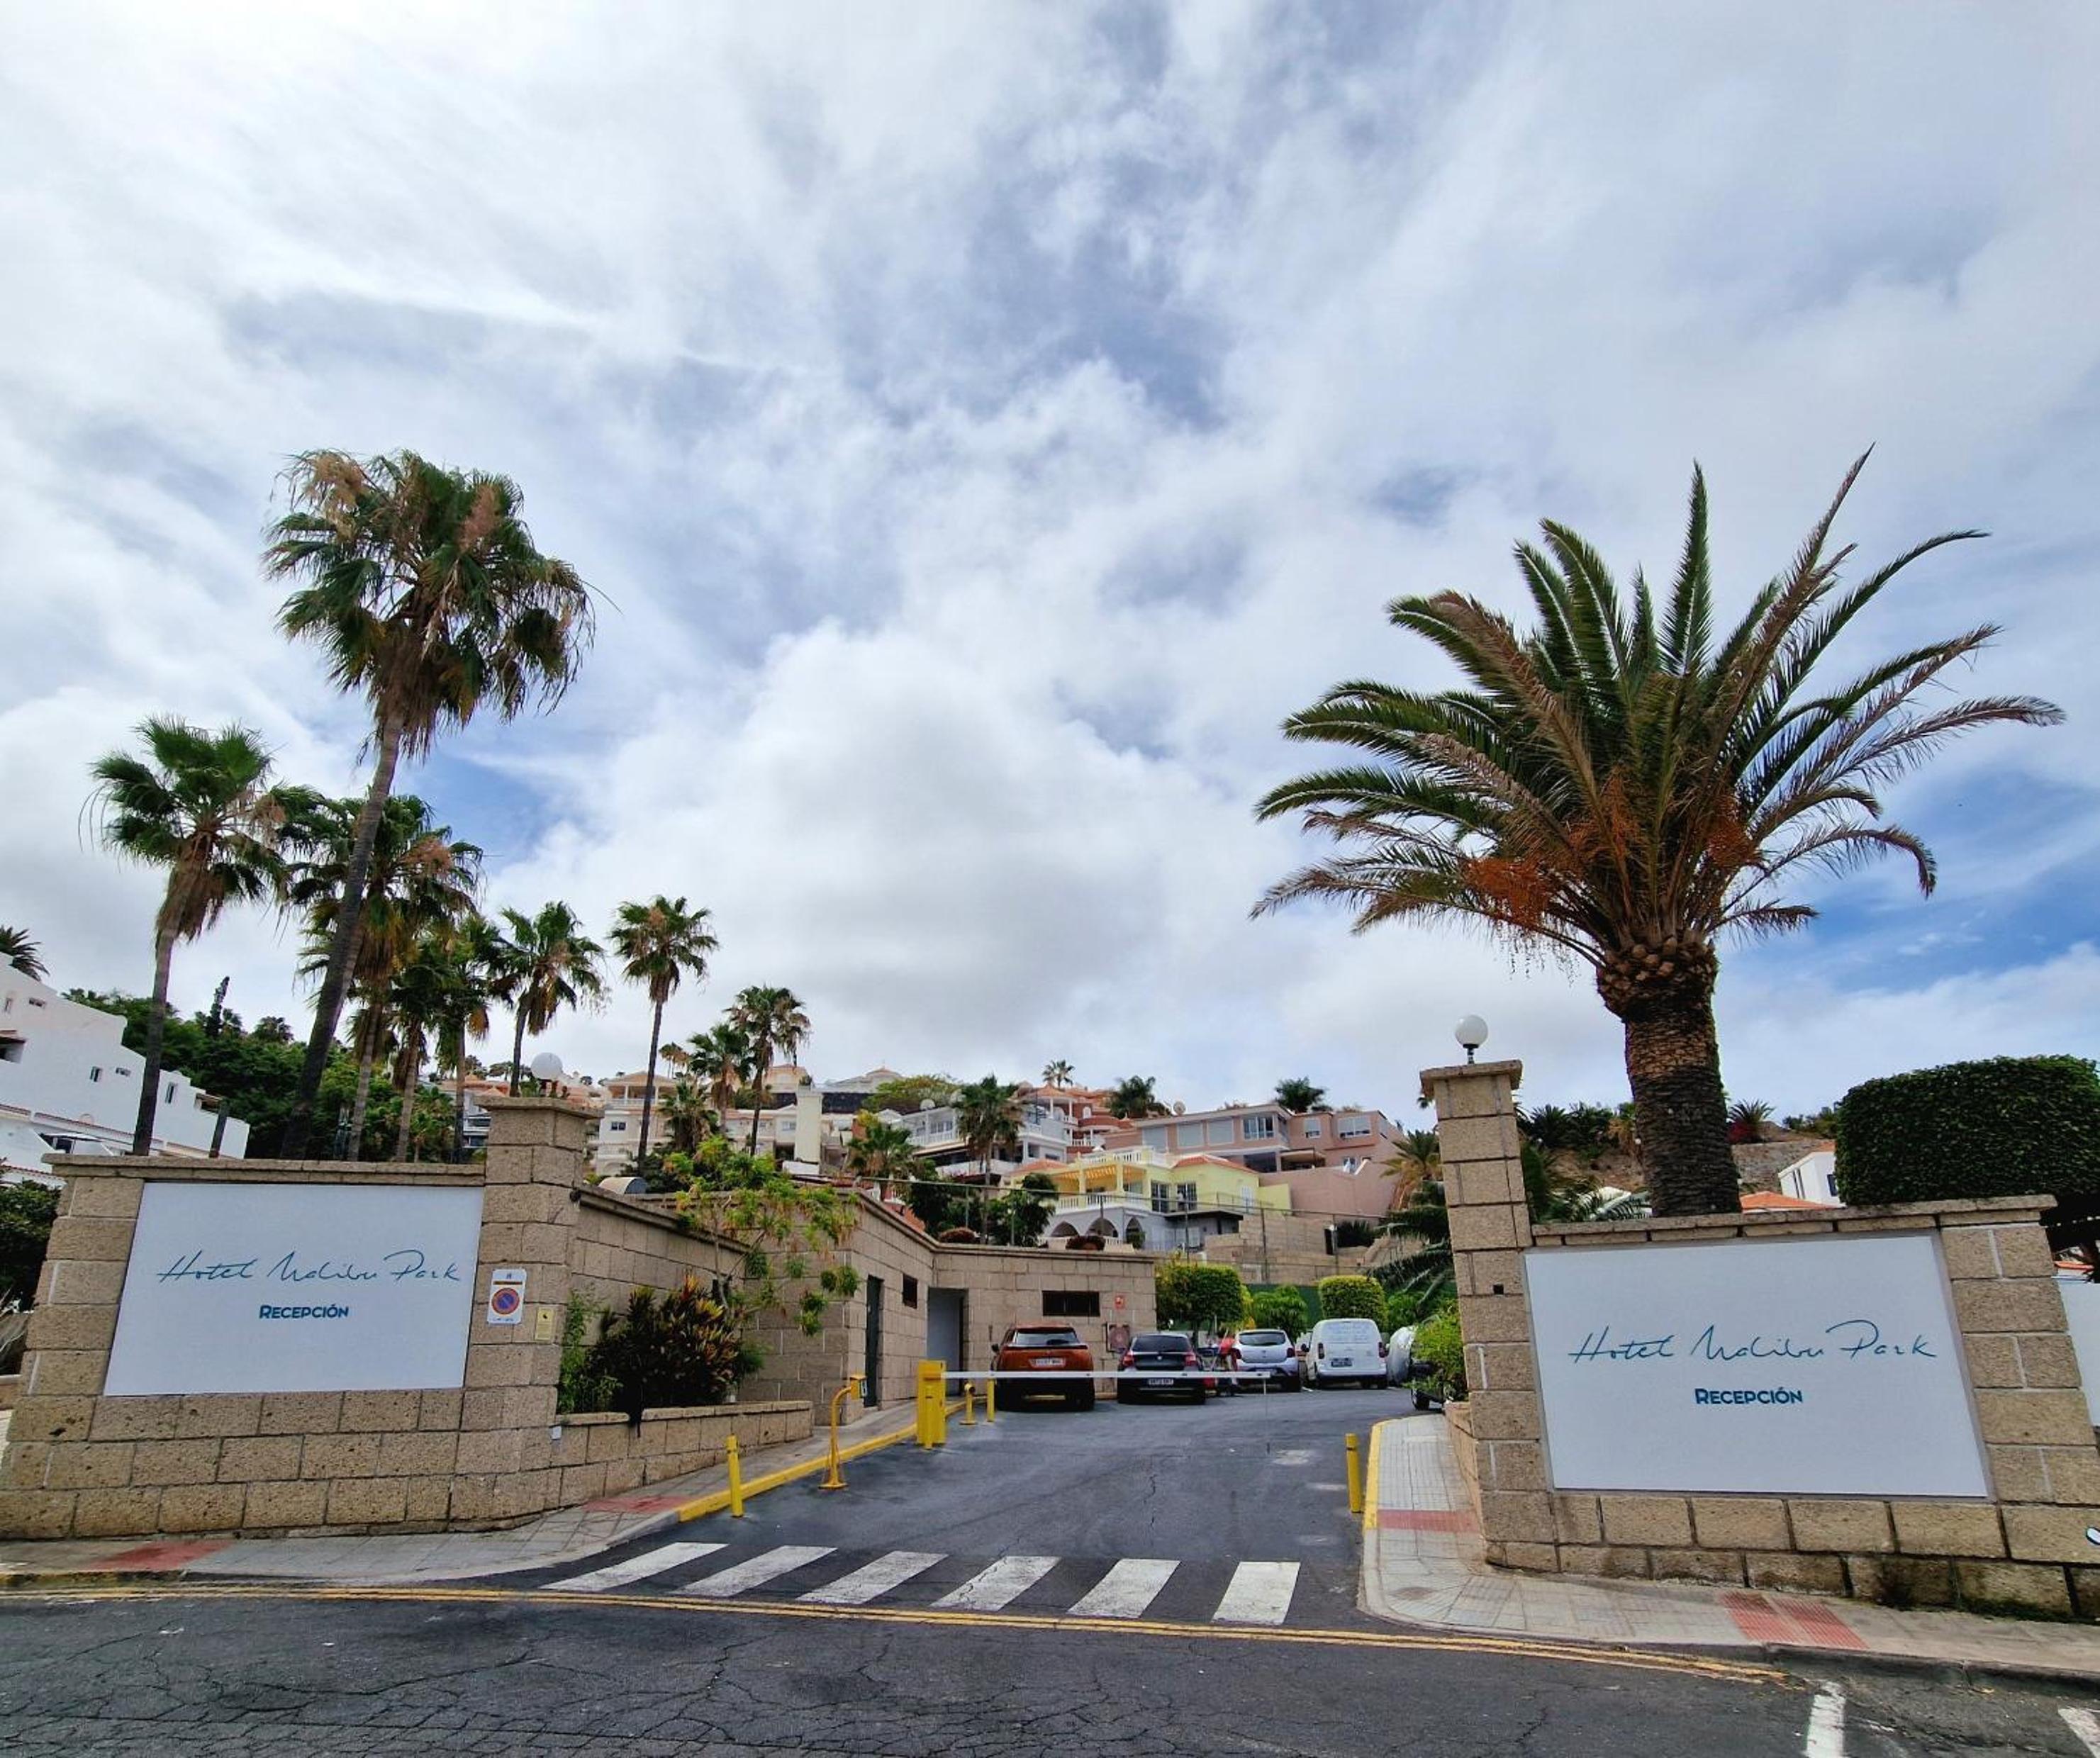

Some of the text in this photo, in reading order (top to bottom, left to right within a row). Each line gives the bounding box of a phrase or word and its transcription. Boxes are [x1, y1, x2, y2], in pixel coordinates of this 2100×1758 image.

[157, 1249, 460, 1282] Hotel Malibu Park
[259, 1304, 350, 1319] RECEPCIÓN
[1568, 1319, 1937, 1363] Hotel Malibu Park
[1694, 1387, 1804, 1405] RECEPCIÓN
